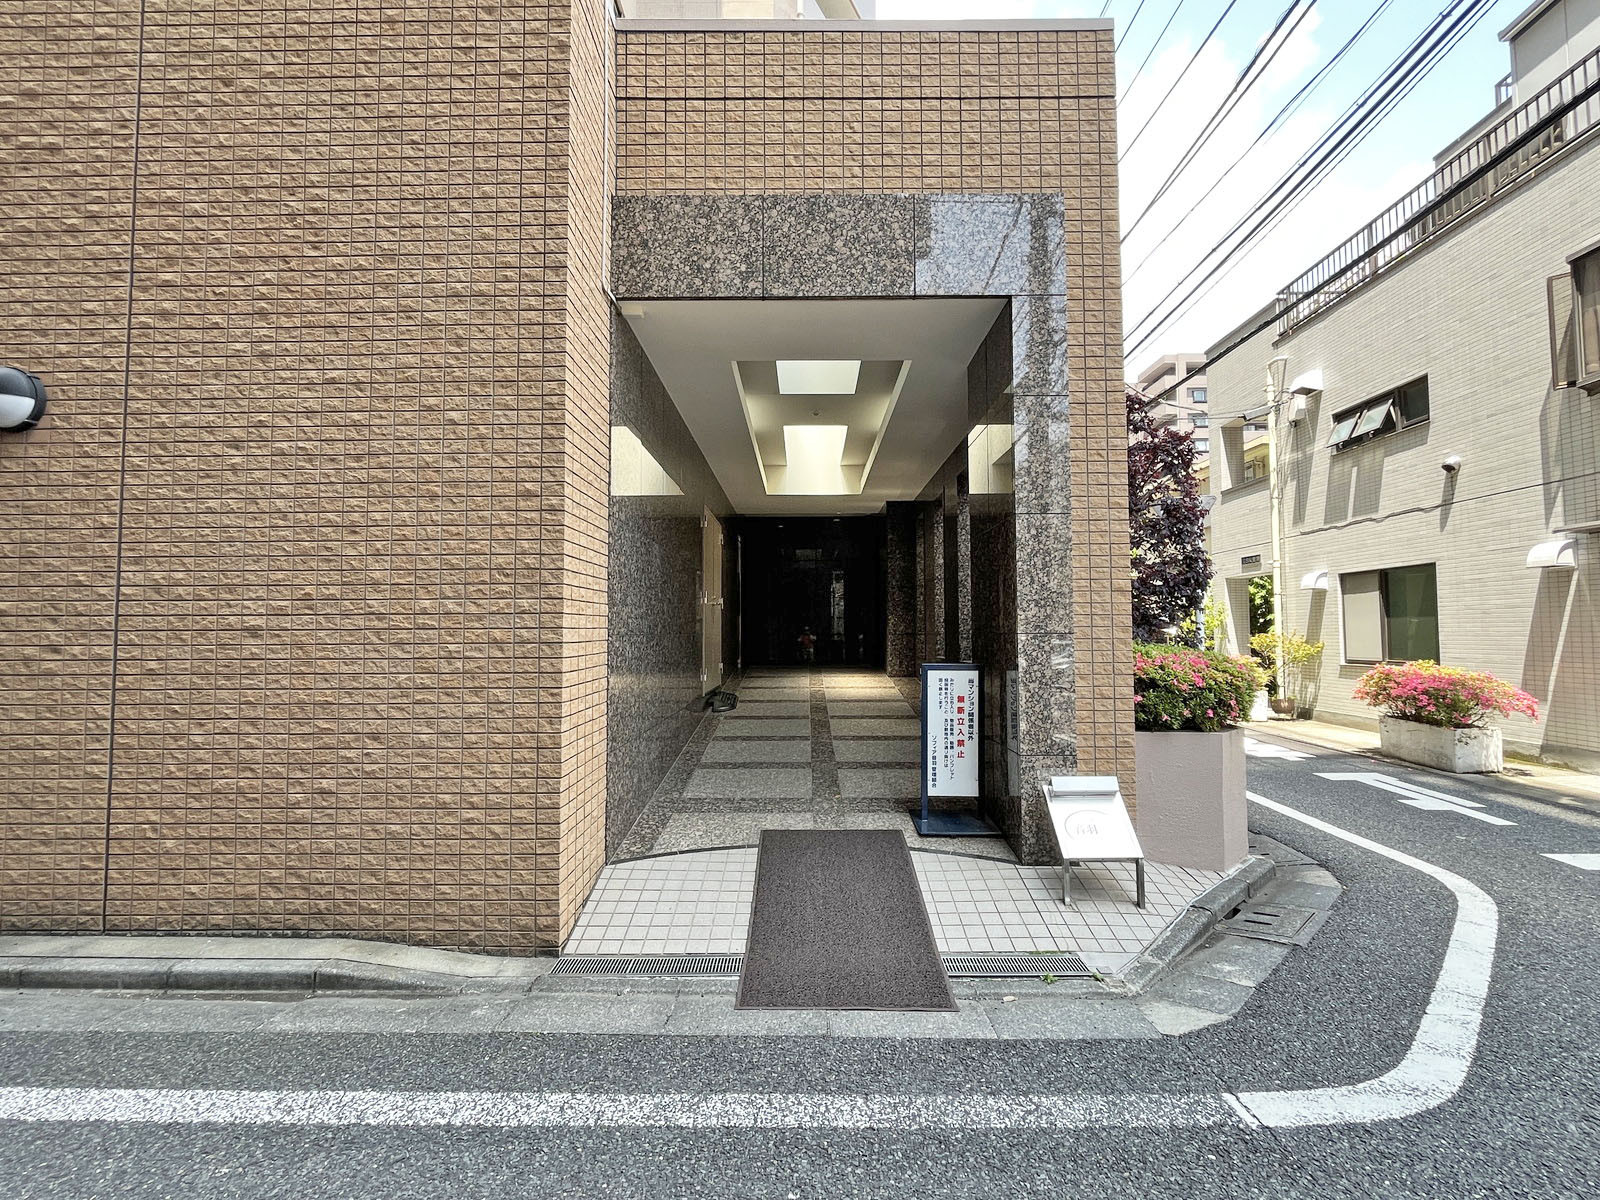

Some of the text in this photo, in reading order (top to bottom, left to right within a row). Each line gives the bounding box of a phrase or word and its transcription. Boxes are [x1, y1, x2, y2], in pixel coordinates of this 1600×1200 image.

[957, 695, 965, 759] 無断立入禁止
